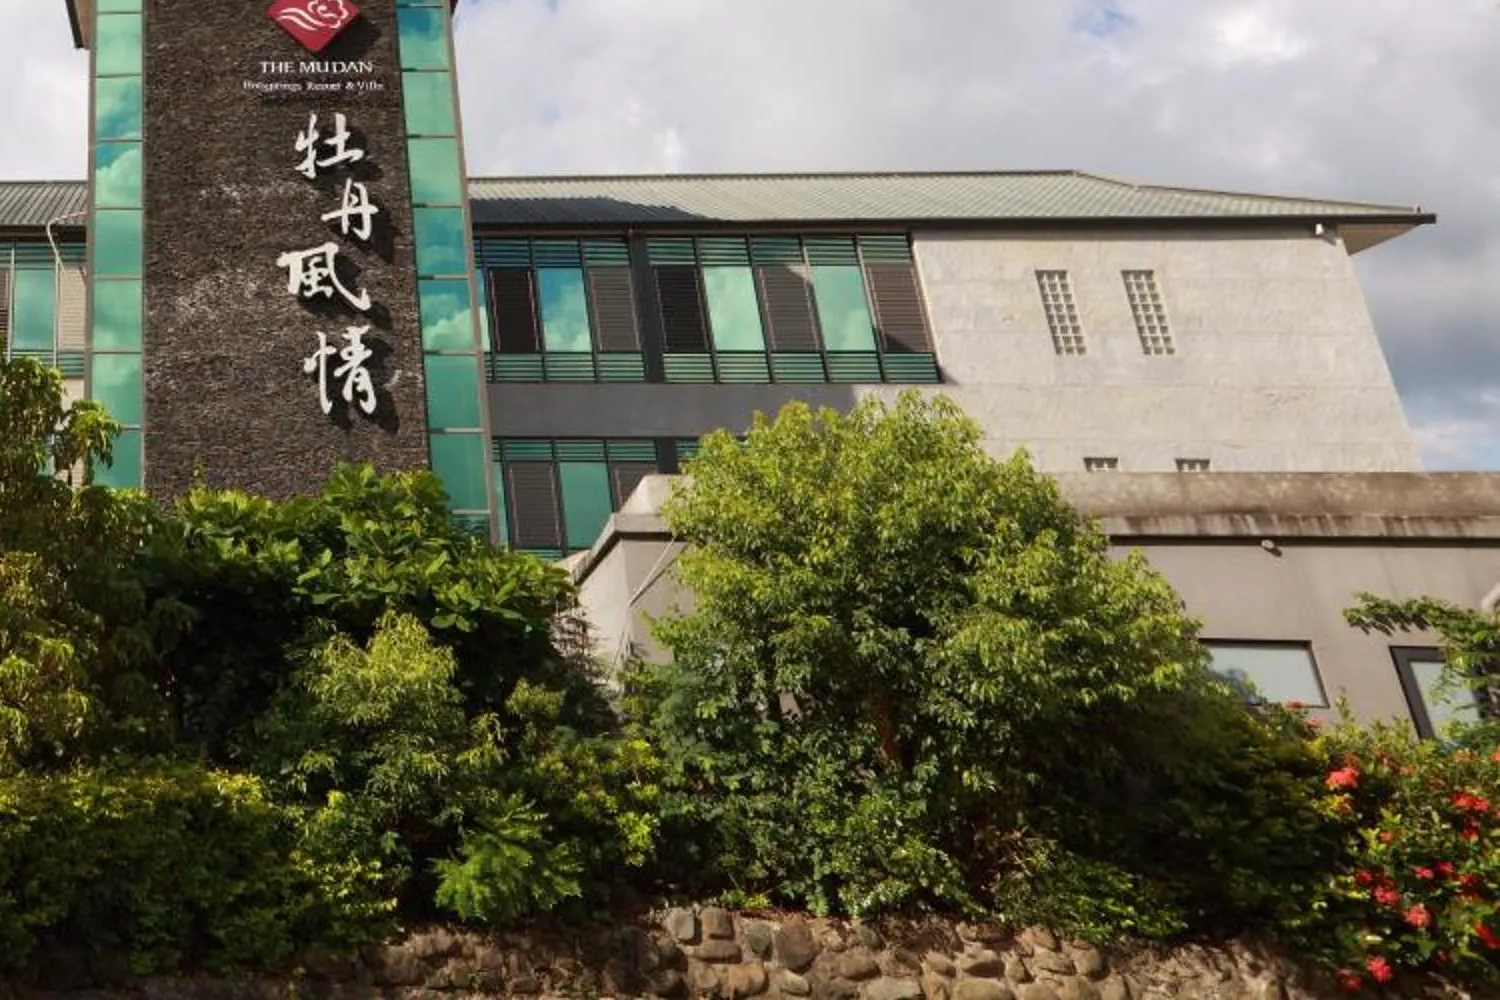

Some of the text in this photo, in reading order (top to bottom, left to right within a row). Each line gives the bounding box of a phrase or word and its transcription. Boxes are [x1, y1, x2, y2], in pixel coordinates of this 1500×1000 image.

[260, 61, 373, 73] THE MUDAN
[345, 81, 355, 90] &
[276, 112, 379, 415] 牡丹風情
